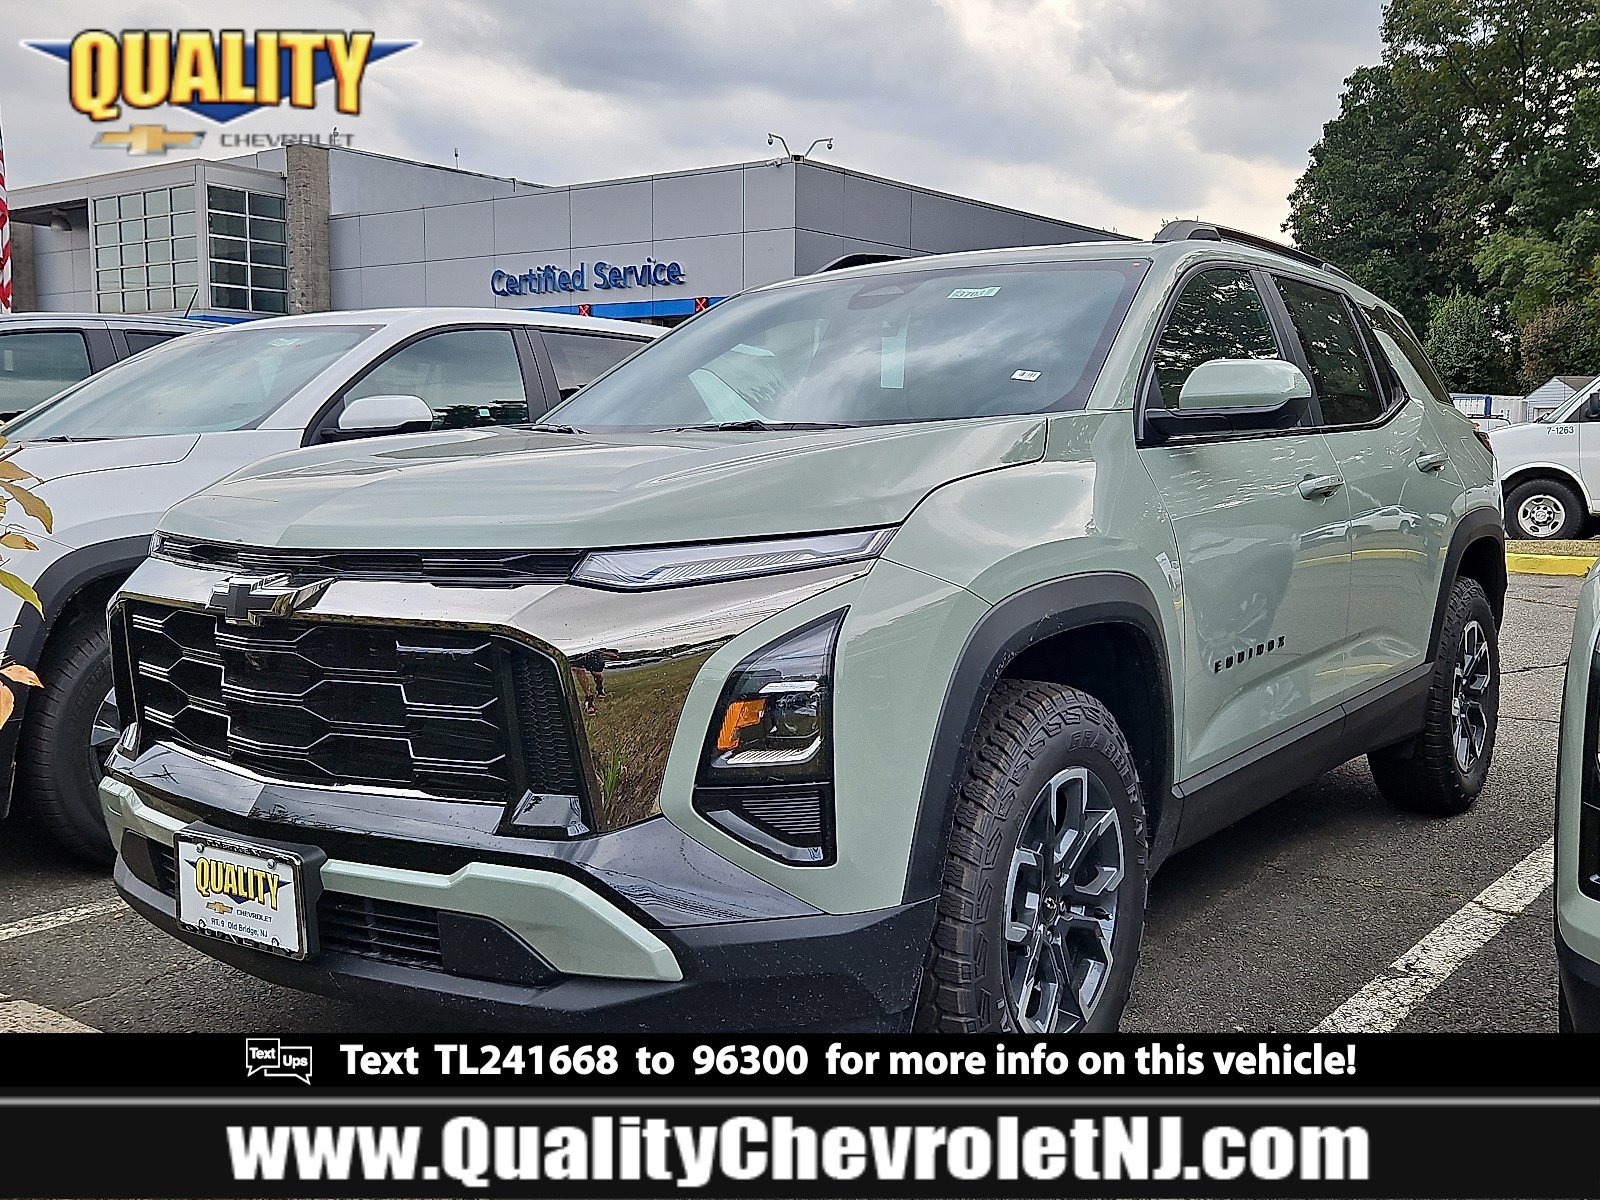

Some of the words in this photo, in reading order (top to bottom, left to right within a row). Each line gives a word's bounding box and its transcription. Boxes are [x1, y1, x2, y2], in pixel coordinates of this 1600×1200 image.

[491, 261, 588, 296] Certified
[593, 257, 685, 289] Service
[1546, 426, 1575, 435] 7-1263
[1213, 635, 1285, 674] EQUINOX
[195, 857, 280, 911] QUALITY
[227, 921, 238, 931] Old
[238, 924, 259, 937] Bridge,
[260, 928, 268, 938] NJ
[236, 909, 273, 924] CHEVROLET
